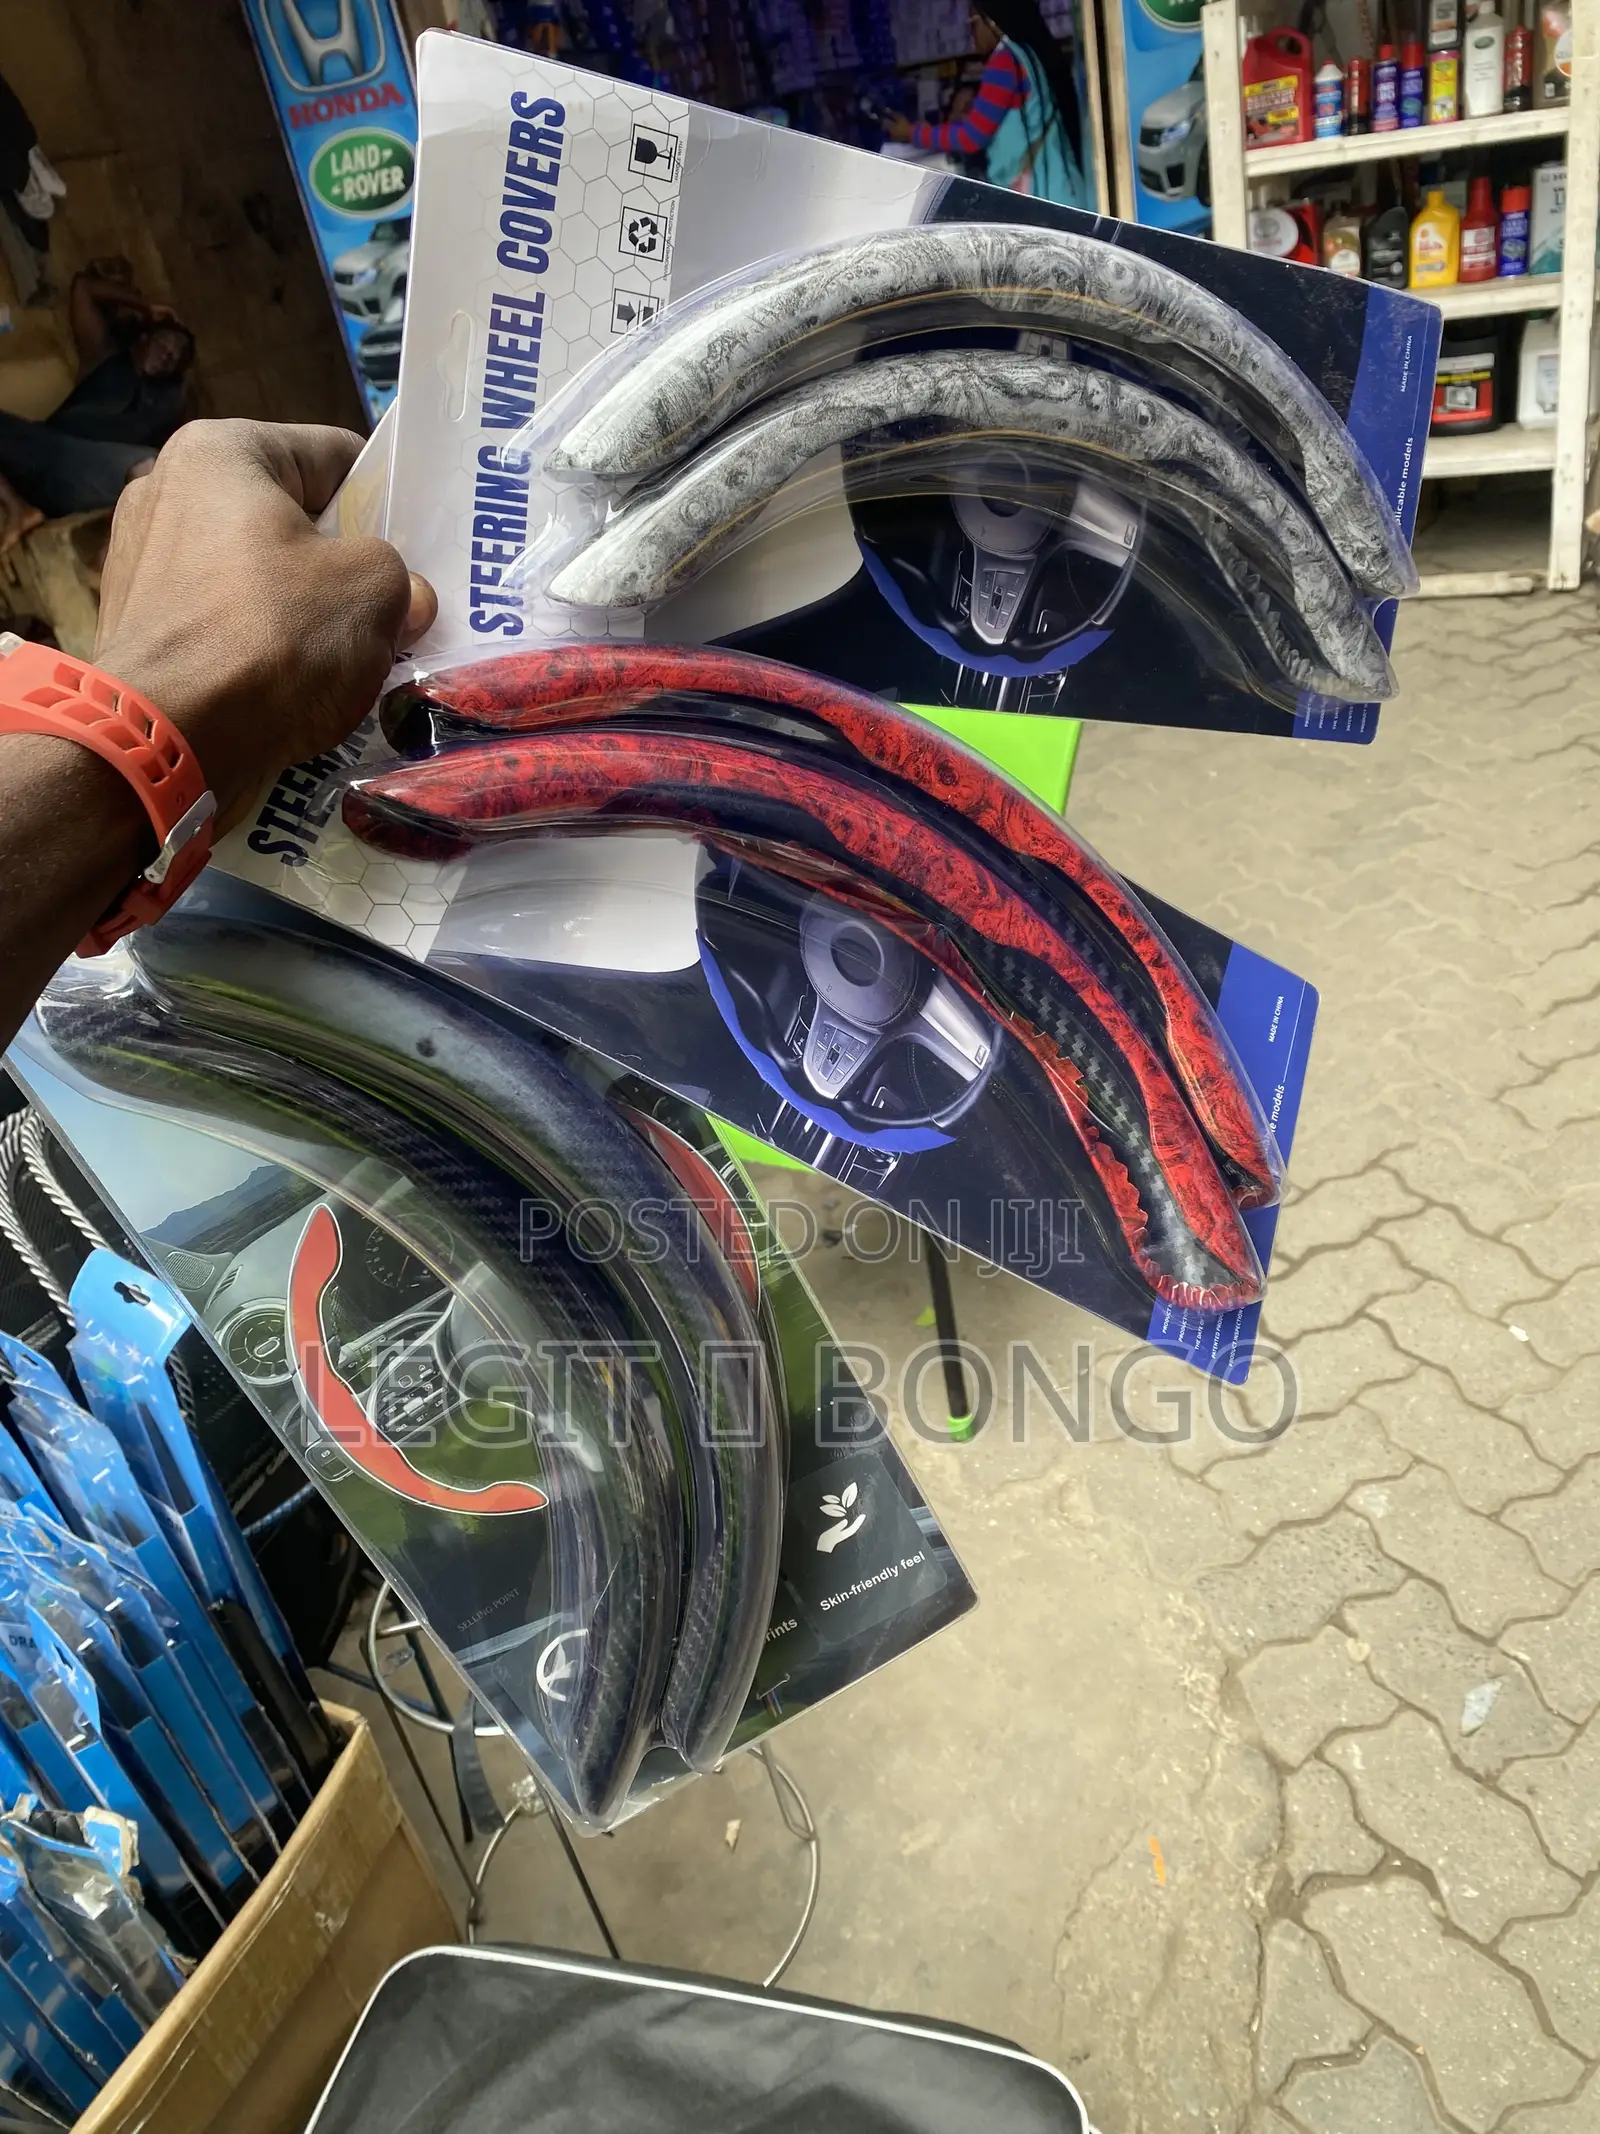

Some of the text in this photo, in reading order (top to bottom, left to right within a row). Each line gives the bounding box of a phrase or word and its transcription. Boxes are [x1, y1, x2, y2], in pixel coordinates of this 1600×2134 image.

[288, 82, 405, 129] HONDA
[331, 144, 380, 177] LAND
[343, 166, 405, 202] ROVER
[469, 91, 566, 636] STEERING WHEEL COVERS
[1402, 437, 1414, 479] models
[1268, 996, 1284, 1042] MADE IN CHINA
[1271, 1084, 1285, 1123] models
[1162, 1308, 1172, 1334] PRODUCT
[820, 1551, 926, 1612] Skin-friendly feel
[457, 1587, 520, 1632] SELLING POINT
